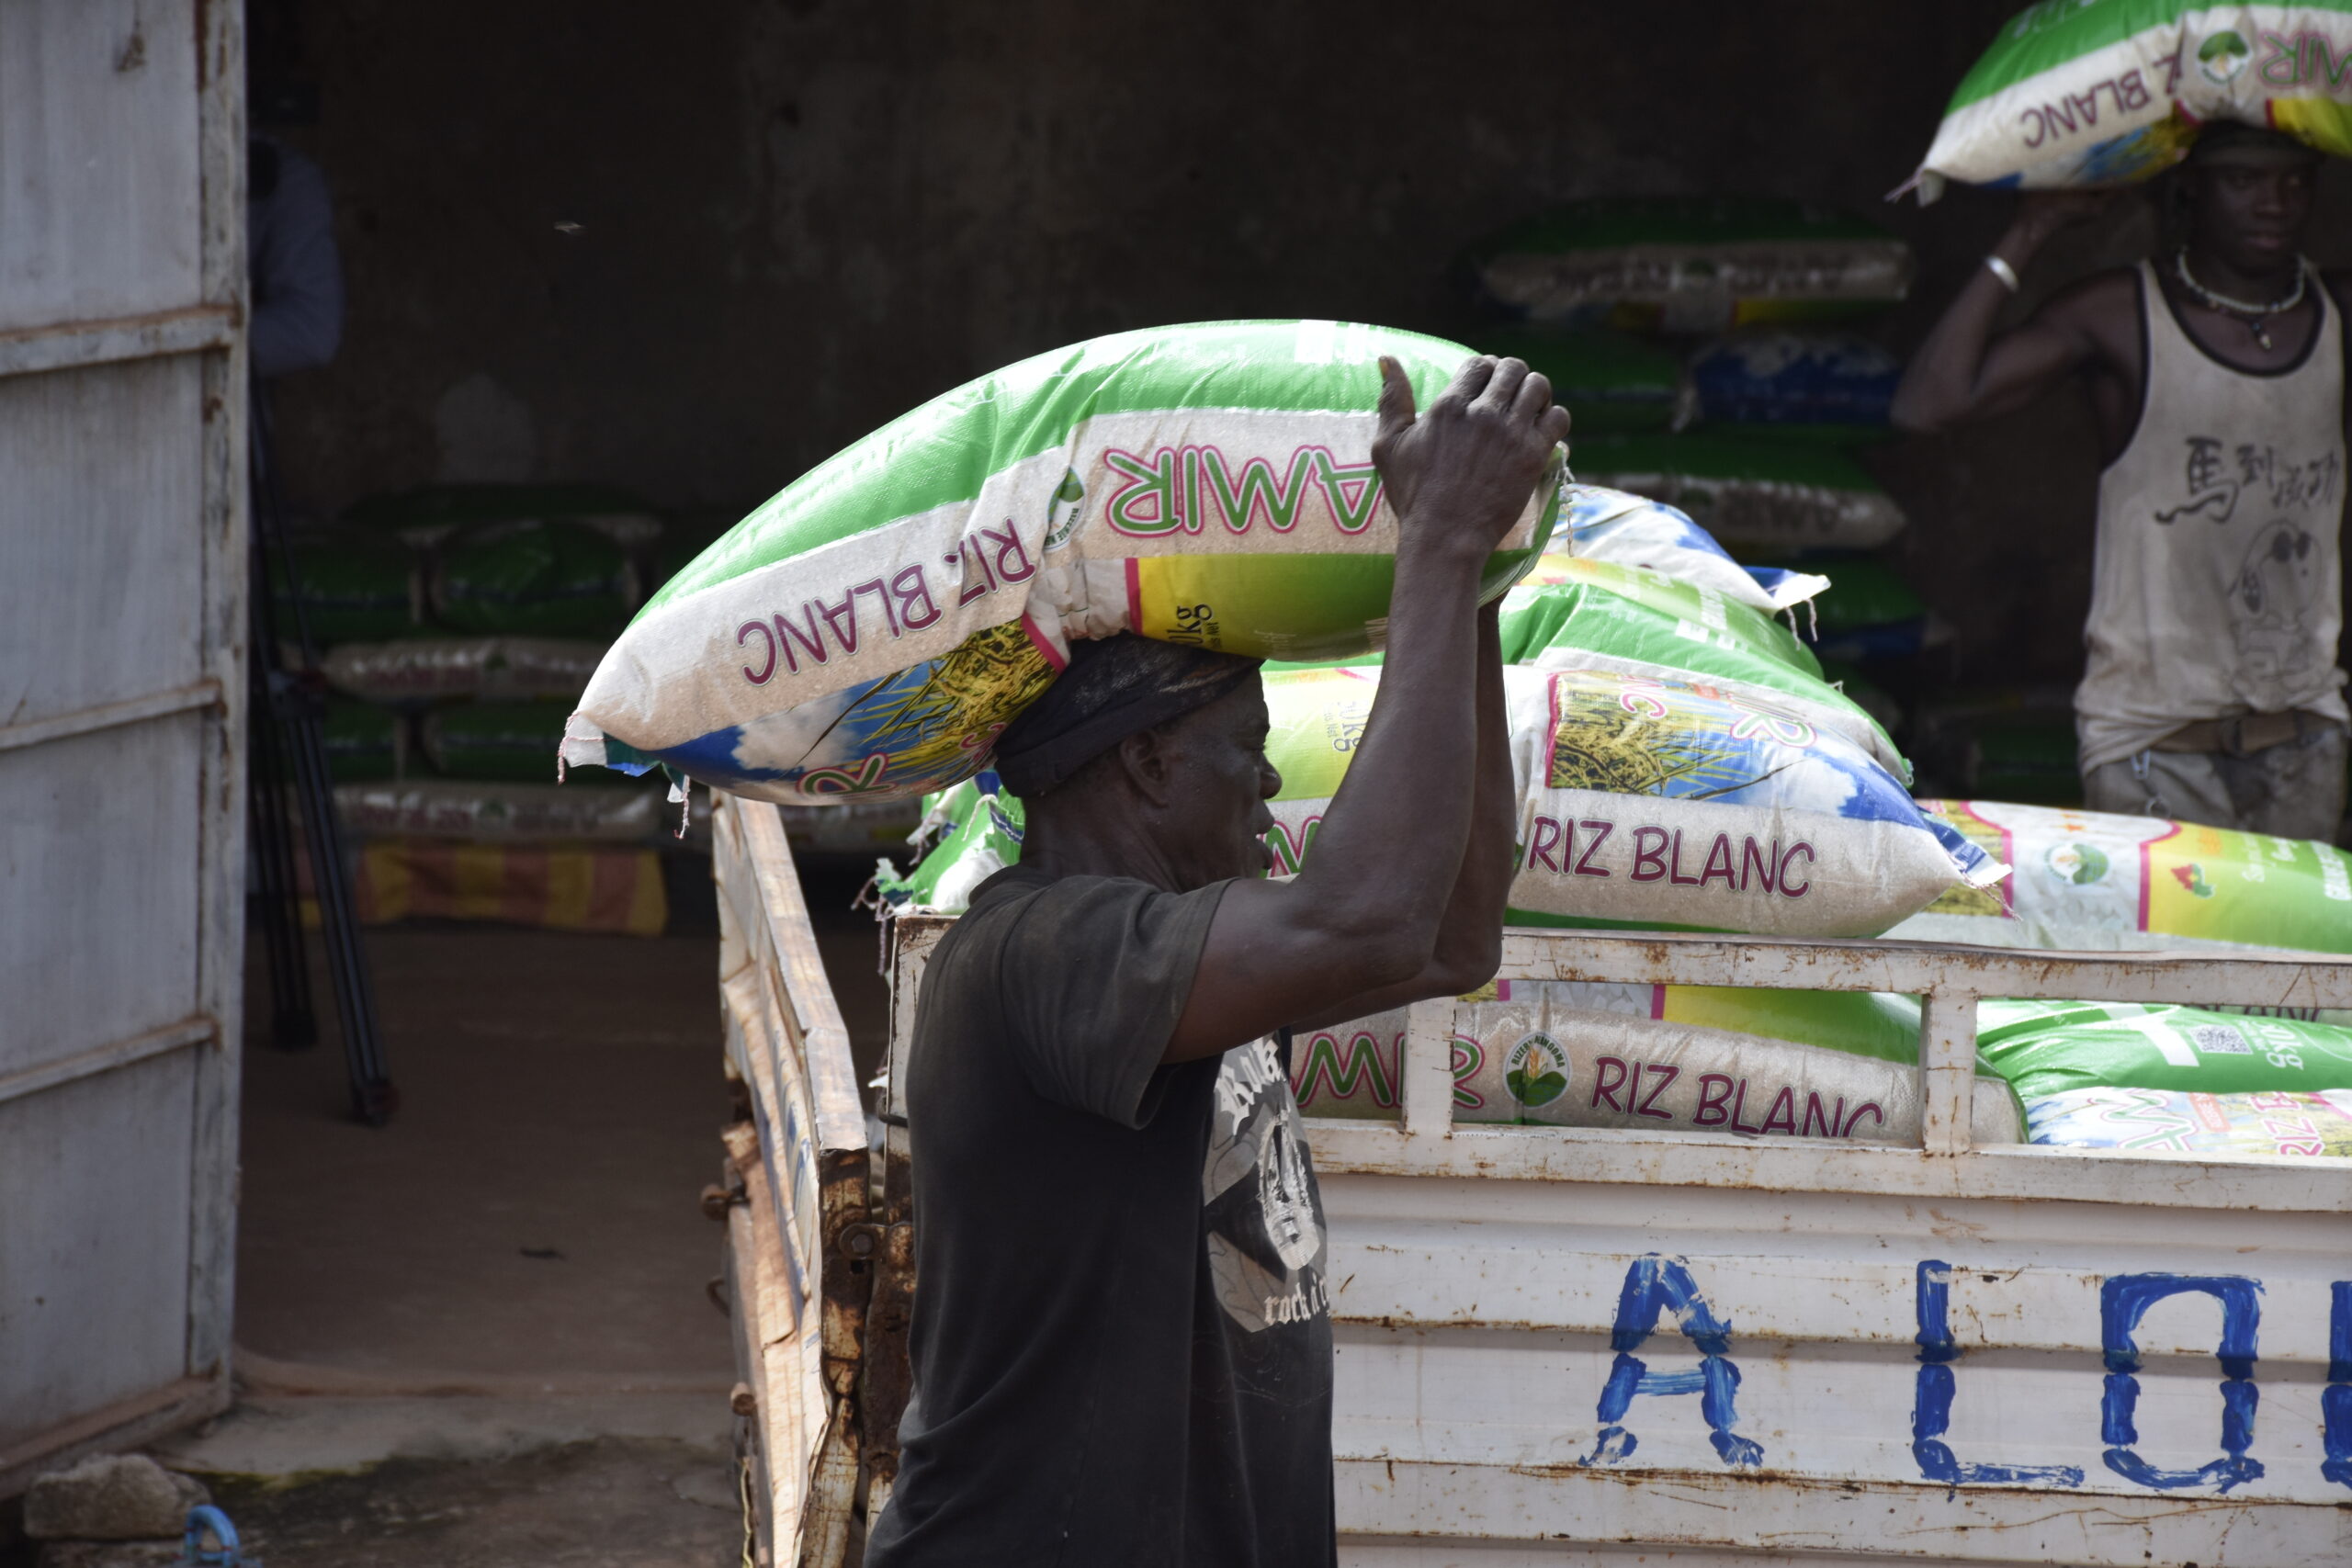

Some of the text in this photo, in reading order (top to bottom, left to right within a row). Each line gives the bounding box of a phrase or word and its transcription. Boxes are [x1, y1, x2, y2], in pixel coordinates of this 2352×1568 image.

[2022, 69, 2152, 150] BLANC
[1102, 446, 1384, 539] AMIR
[737, 563, 943, 686] BLANC
[1526, 815, 1818, 899] RIZ BLANC
[1590, 1055, 1682, 1122] RIZ
